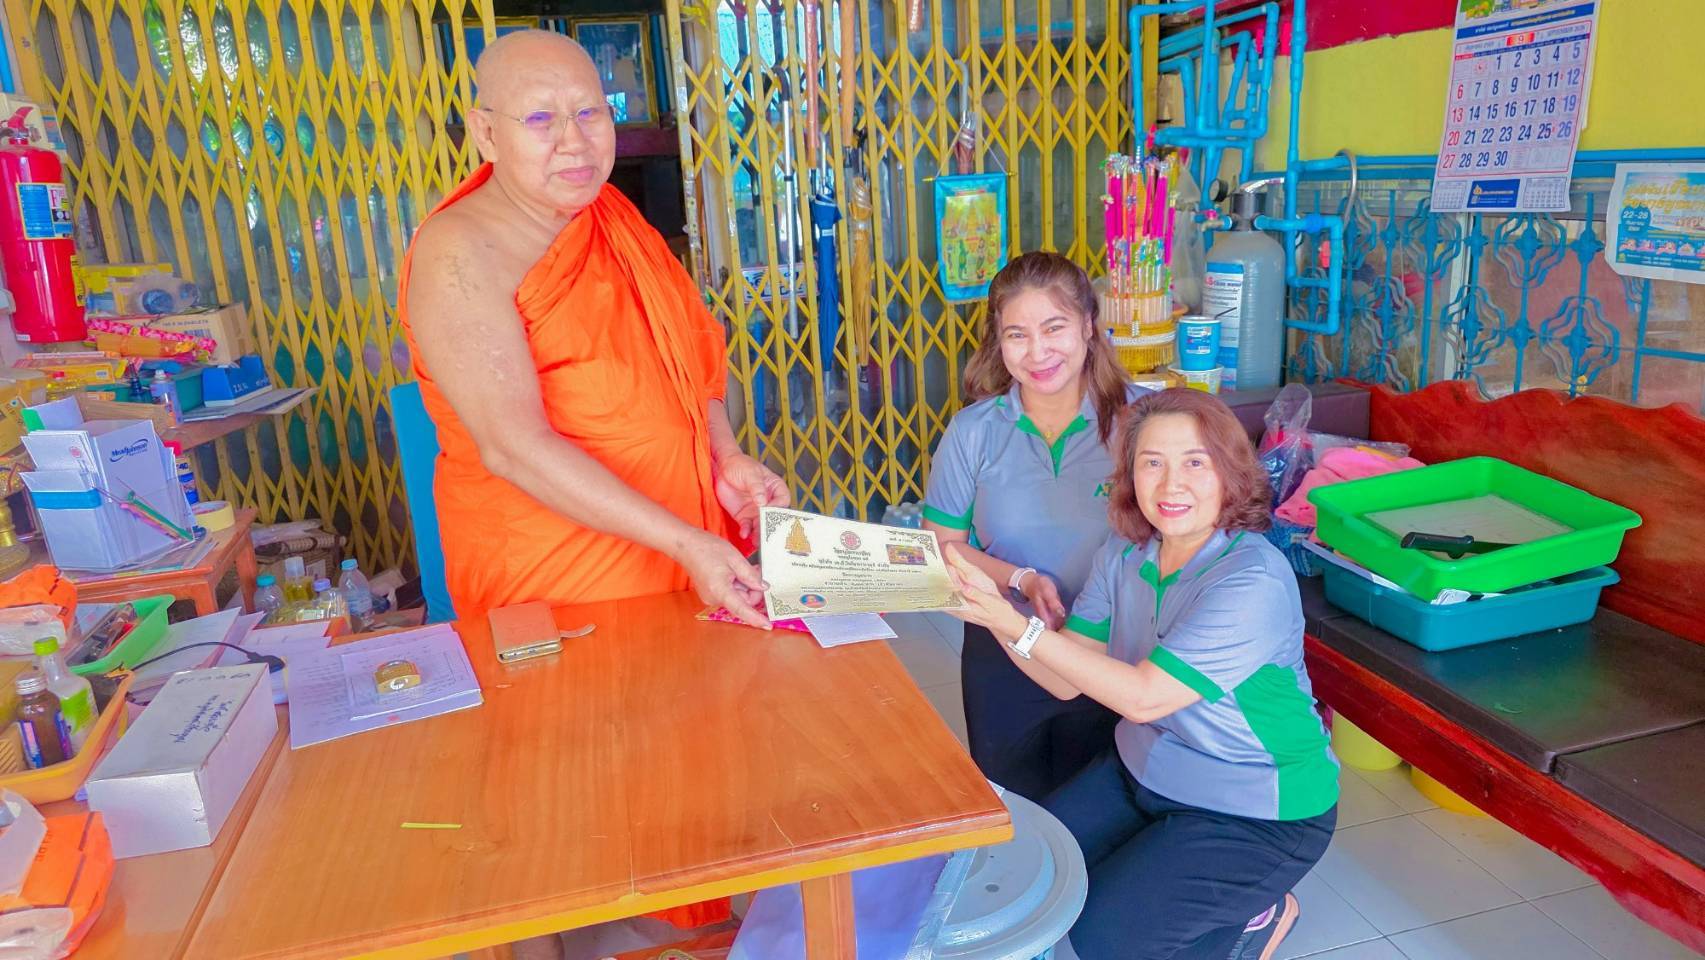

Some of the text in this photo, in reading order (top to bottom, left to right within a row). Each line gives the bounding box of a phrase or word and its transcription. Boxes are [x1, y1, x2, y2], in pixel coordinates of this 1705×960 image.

[1496, 56, 1501, 70] 1
[1514, 52, 1522, 67] 2
[1534, 49, 1541, 64] 3
[1553, 46, 1560, 61] 4
[1573, 43, 1580, 58] 5
[1457, 68, 1580, 99] 6 7 8 9 10 11 12
[1453, 95, 1577, 123] 13 14 15 16 17 18 19
[1448, 121, 1572, 145] 20 21 22 23 24 25 26
[1443, 151, 1508, 169] 27 28 29 30
